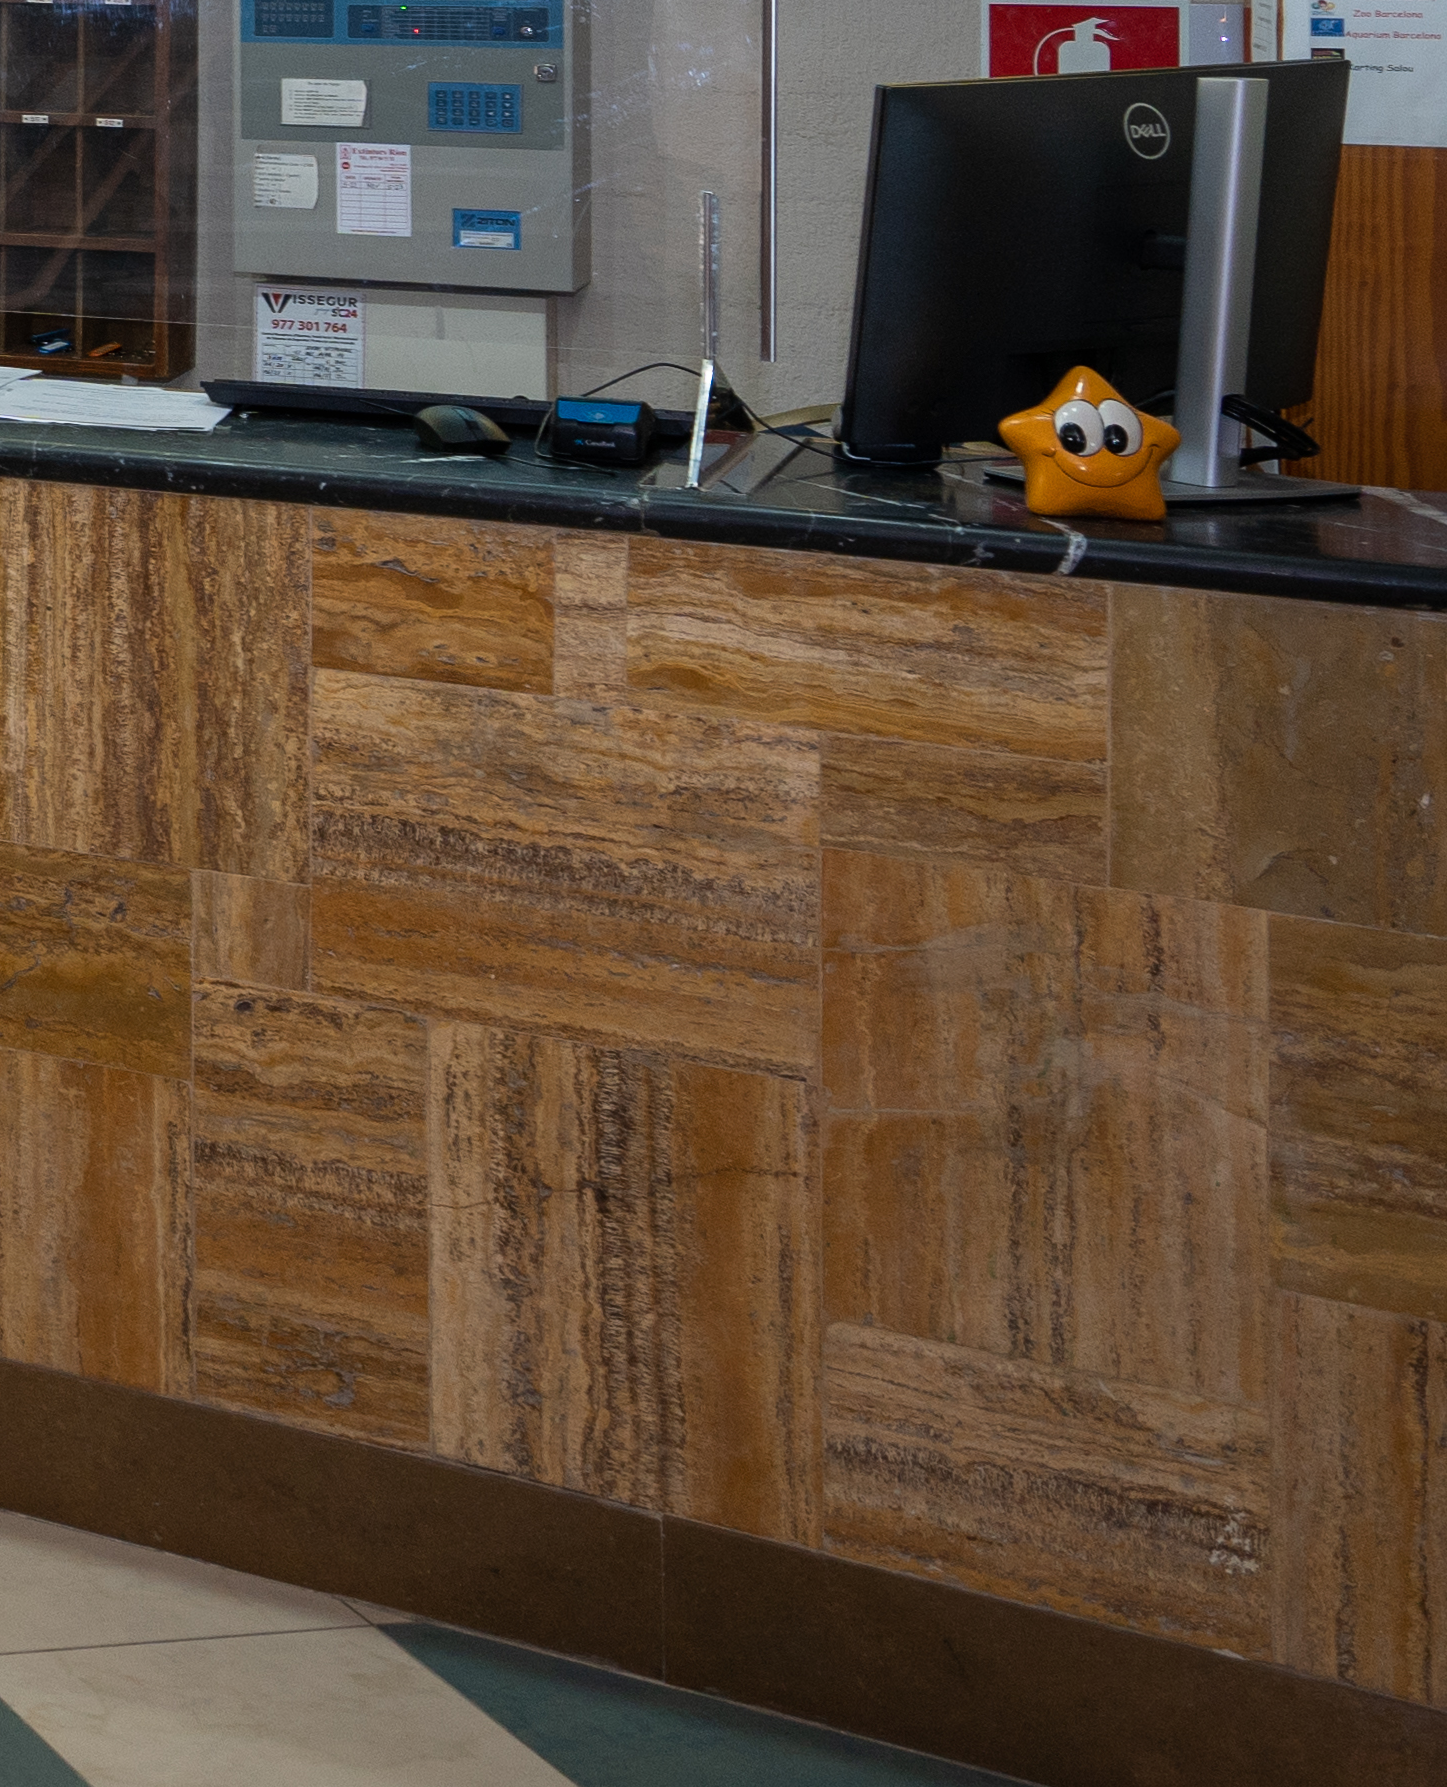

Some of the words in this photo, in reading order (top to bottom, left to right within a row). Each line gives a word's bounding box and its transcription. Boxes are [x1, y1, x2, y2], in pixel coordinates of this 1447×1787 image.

[1353, 10, 1371, 18] Zoo
[1375, 10, 1423, 18] Barcelona
[1346, 31, 1390, 40] Aquarium
[1393, 31, 1441, 40] Barcelona
[1387, 64, 1414, 73] Salou
[1130, 123, 1167, 138] DELL
[271, 319, 295, 330] 977
[297, 320, 320, 331] 301
[324, 322, 347, 333] 764
